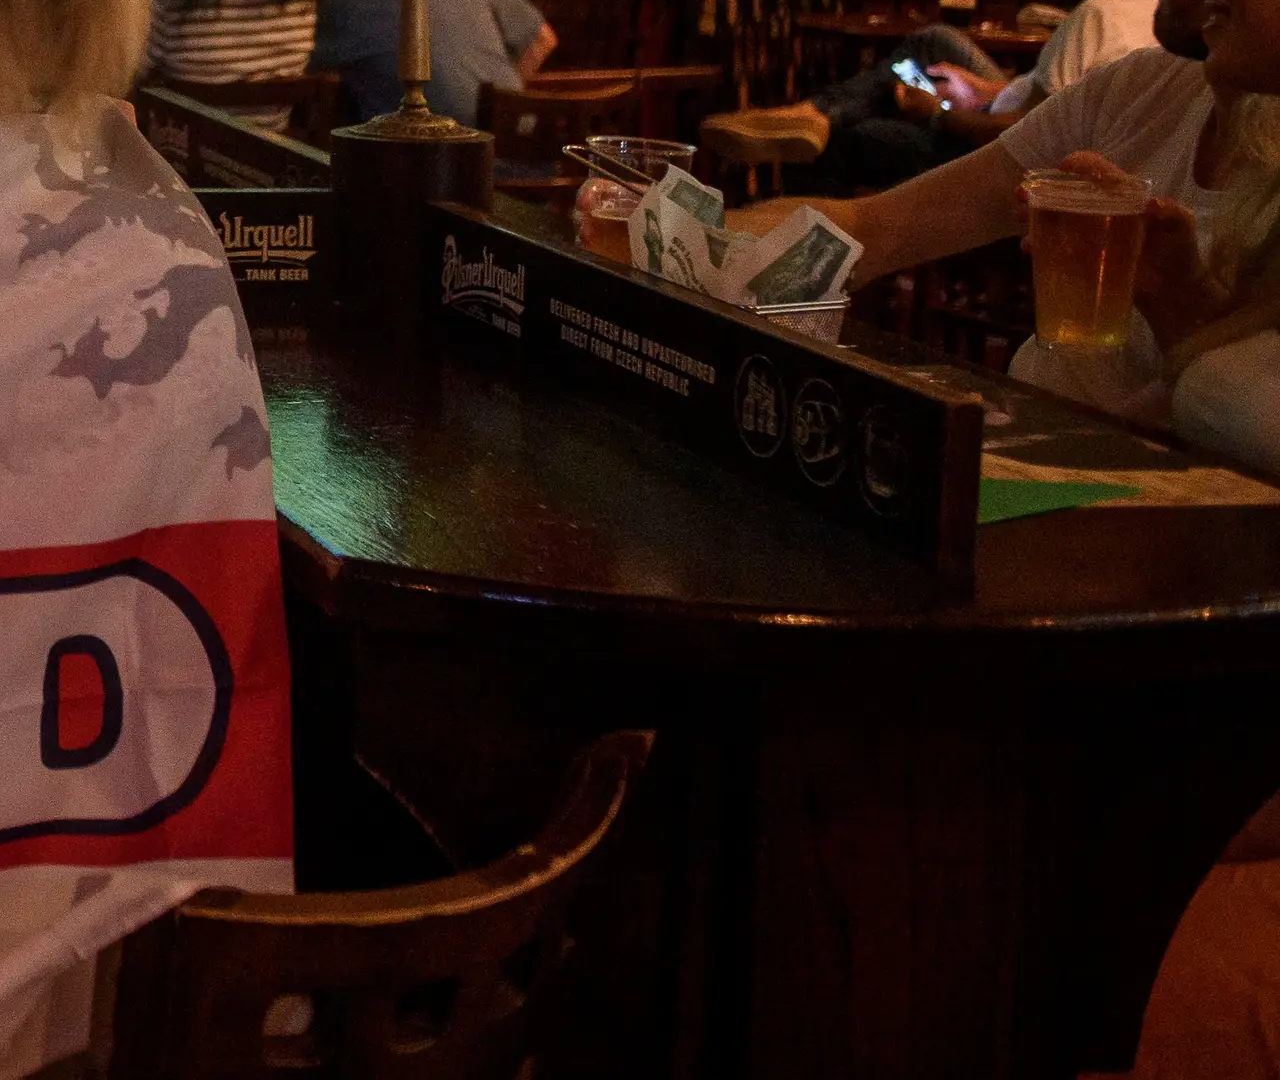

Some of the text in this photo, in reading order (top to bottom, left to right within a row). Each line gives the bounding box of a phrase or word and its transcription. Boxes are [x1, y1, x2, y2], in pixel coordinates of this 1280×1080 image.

[219, 210, 314, 262] Urquell
[245, 268, 309, 282] TANK BEER
[441, 234, 525, 308] Pilsner Urquell
[550, 296, 592, 331] DELIVERED
[592, 315, 621, 343] FRESH
[621, 328, 640, 352] AND
[560, 323, 690, 397] DIRECT FROM CZECH REPUBLIC
